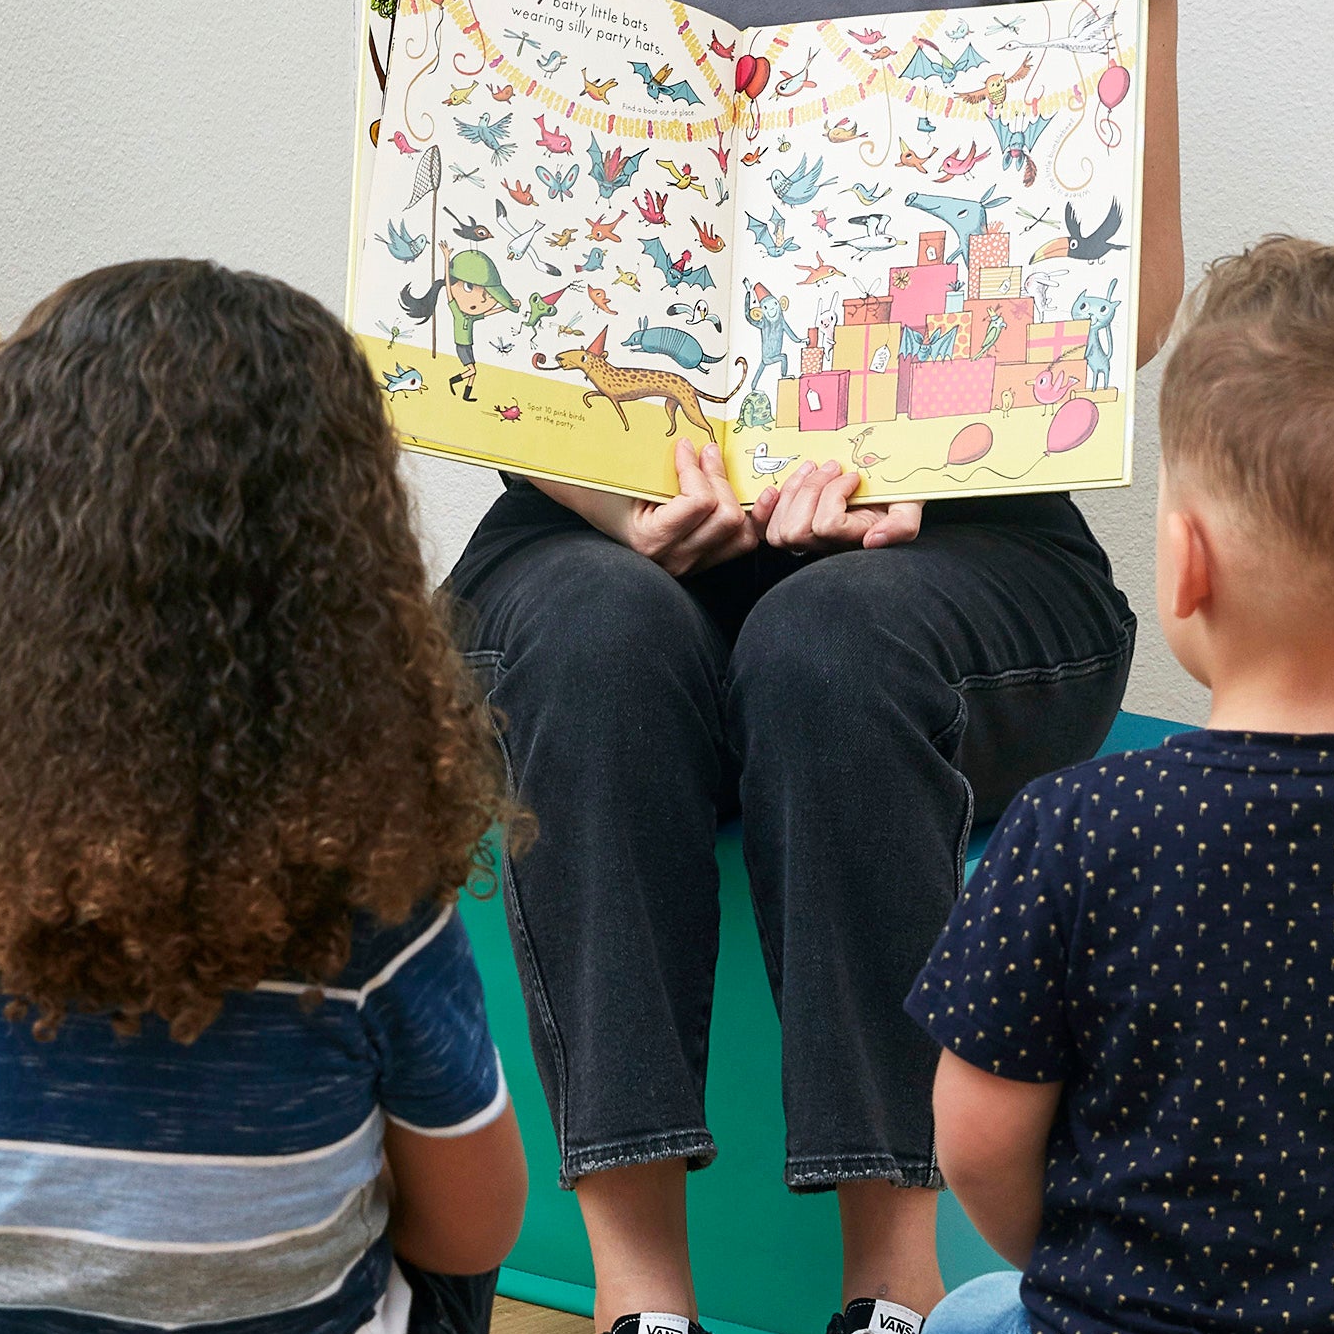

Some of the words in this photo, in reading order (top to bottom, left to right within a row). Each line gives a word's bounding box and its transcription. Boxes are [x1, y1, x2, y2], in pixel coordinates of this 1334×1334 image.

[592, 3, 618, 24] little
[622, 12, 649, 33] bats
[511, 6, 564, 31] wearing
[568, 19, 592, 39] silly
[596, 29, 631, 49] party
[635, 36, 664, 56] hats.
[622, 102, 636, 112] Find
[671, 108, 678, 116] of
[527, 402, 542, 412] Spot
[545, 406, 552, 414] 10
[553, 409, 566, 417] pink
[569, 411, 585, 422] birds
[544, 416, 554, 424] the
